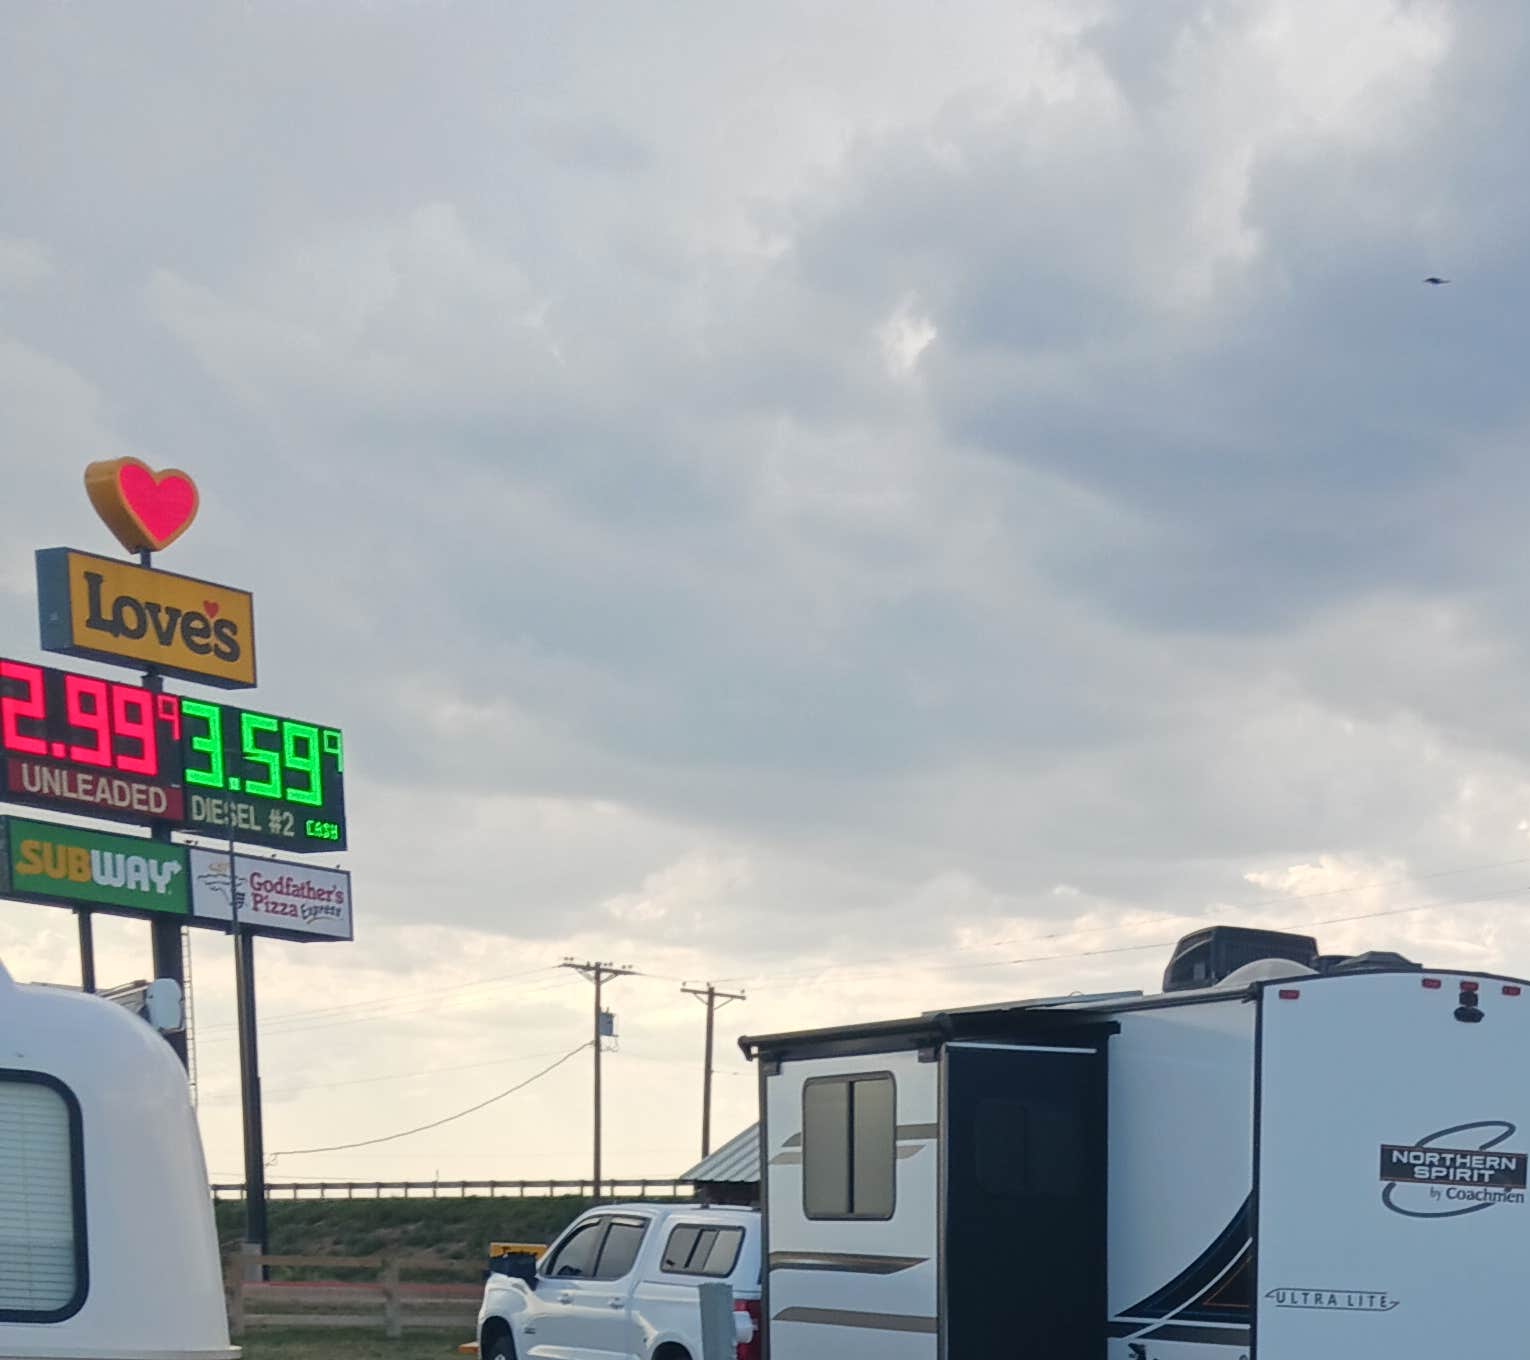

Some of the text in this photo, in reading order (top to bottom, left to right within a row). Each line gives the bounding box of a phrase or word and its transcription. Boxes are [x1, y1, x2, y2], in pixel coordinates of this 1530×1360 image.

[21, 762, 168, 815] UNLEADED
[190, 794, 297, 838] DIESEL #2
[14, 839, 182, 895] SUBWAY
[249, 872, 345, 905] Godfather's
[251, 892, 299, 918] Pizza
[1391, 1150, 1517, 1171] NORTHERN
[1413, 1165, 1496, 1183] SPIRIT
[1430, 1186, 1525, 1204] by Coachmen
[1275, 1291, 1388, 1308] ULTRA LITE
